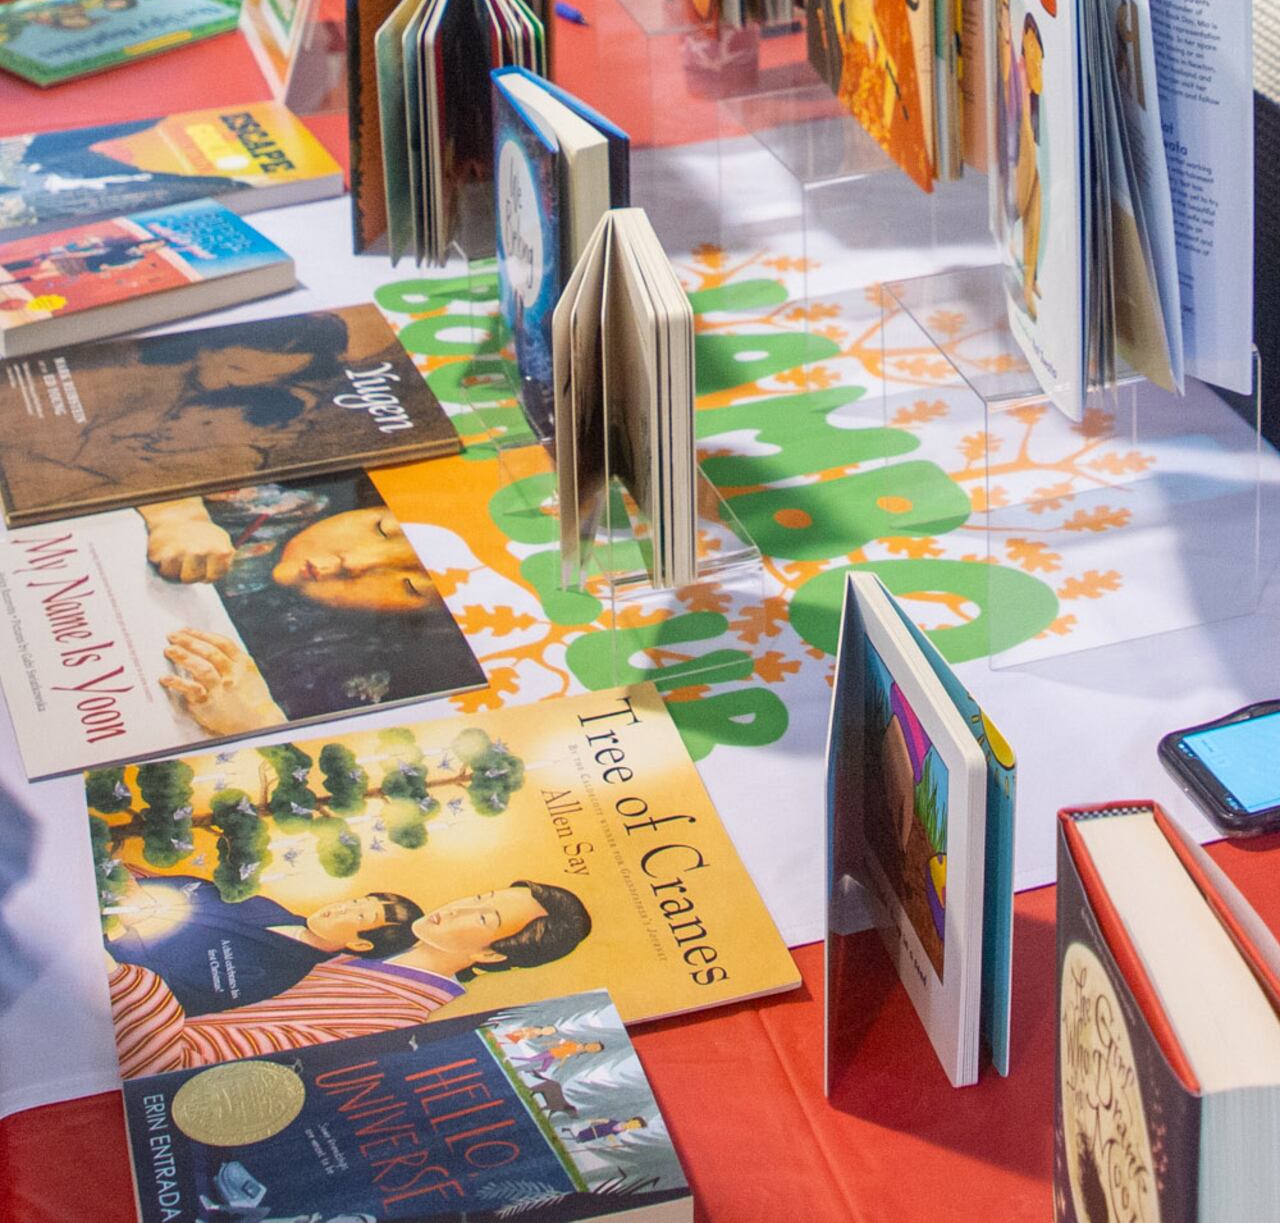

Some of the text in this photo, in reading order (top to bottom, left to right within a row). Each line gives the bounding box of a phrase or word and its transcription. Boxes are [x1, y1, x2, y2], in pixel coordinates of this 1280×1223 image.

[220, 110, 296, 175] ESCAPE
[334, 361, 416, 434] Yugen
[10, 533, 78, 574] My
[26, 575, 95, 643] Name
[61, 640, 115, 667] Is
[50, 665, 135, 743] Yoon
[541, 788, 594, 876] Allen Say
[577, 696, 730, 986] Tree of Cranes
[315, 1060, 466, 1213] UNIVERSE
[404, 1057, 520, 1177] HELLO,
[142, 1093, 183, 1223] ERIN ENTRADA
